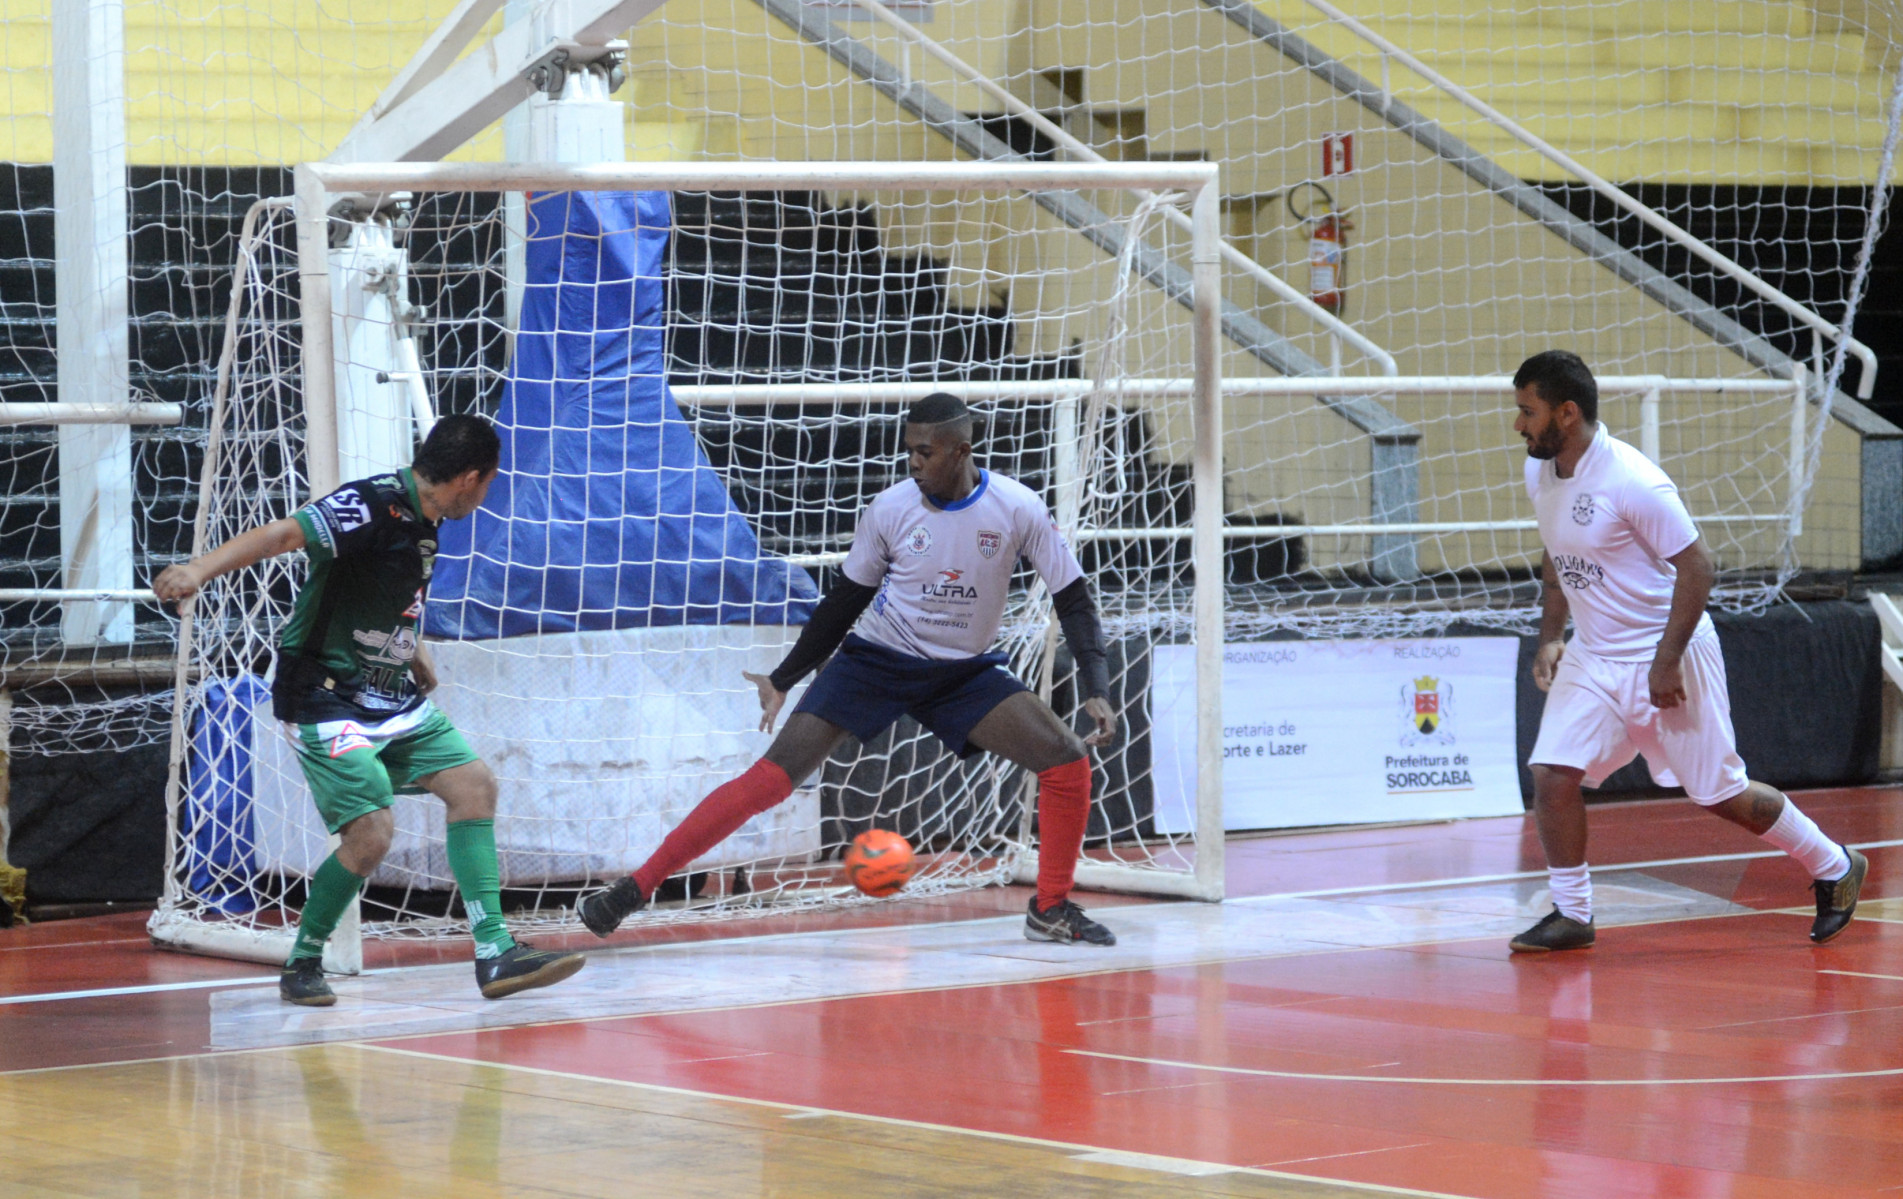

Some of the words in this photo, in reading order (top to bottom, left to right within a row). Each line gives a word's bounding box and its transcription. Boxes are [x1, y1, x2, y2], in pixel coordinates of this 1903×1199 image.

[1554, 554, 1604, 580] OLIGAN'S
[922, 583, 978, 598] ULTRA
[1223, 649, 1297, 666] RGANIZAÇÃO
[1393, 645, 1461, 660] REALIZAÇÃO
[1223, 721, 1275, 738] cretaria
[1278, 719, 1297, 736] de
[1223, 743, 1252, 758] orte
[1255, 745, 1265, 757] e
[1269, 741, 1308, 756] Lazer
[1385, 755, 1449, 768] Prefeitura
[1453, 753, 1469, 766] de
[1386, 769, 1473, 789] SOROCABA
